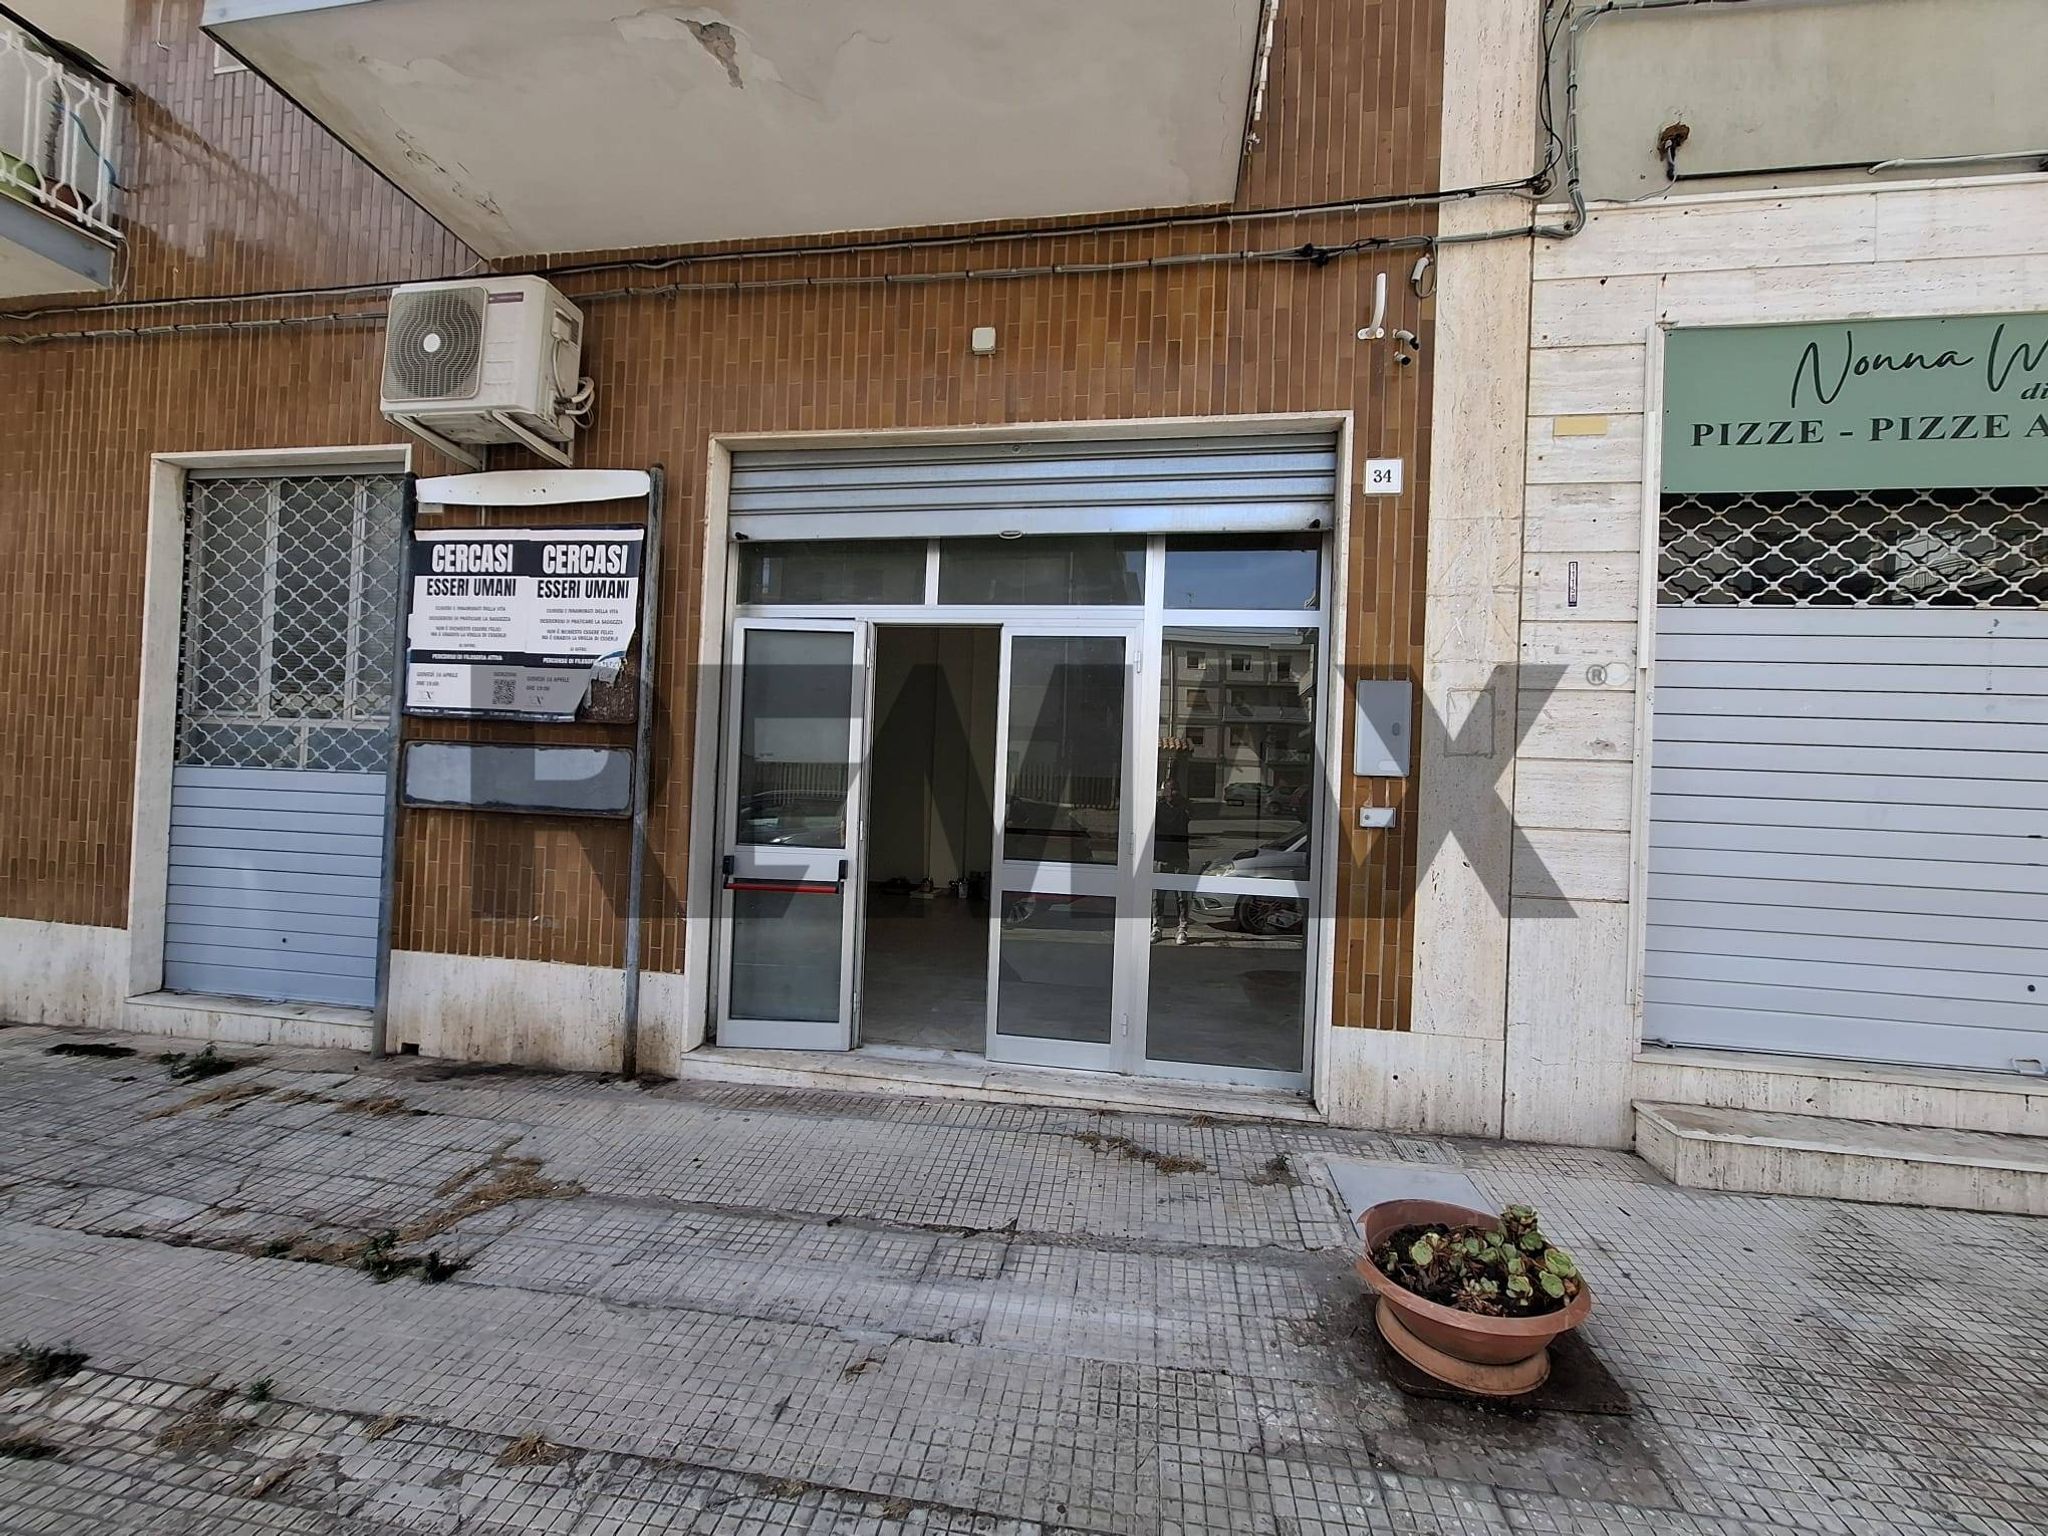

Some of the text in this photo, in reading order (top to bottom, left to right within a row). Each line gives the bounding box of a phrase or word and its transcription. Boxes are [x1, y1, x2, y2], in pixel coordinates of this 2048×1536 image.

[1791, 330, 1974, 408] Nonna
[1690, 420, 1825, 447] PIZZE
[1869, 414, 2011, 442] PIZZE
[1373, 469, 1392, 483] 34
[431, 543, 514, 573] CERCASI
[542, 544, 629, 574] CERCASI
[426, 578, 517, 597] ESSERI UMANI
[537, 579, 630, 599] ESSERI UMANI
